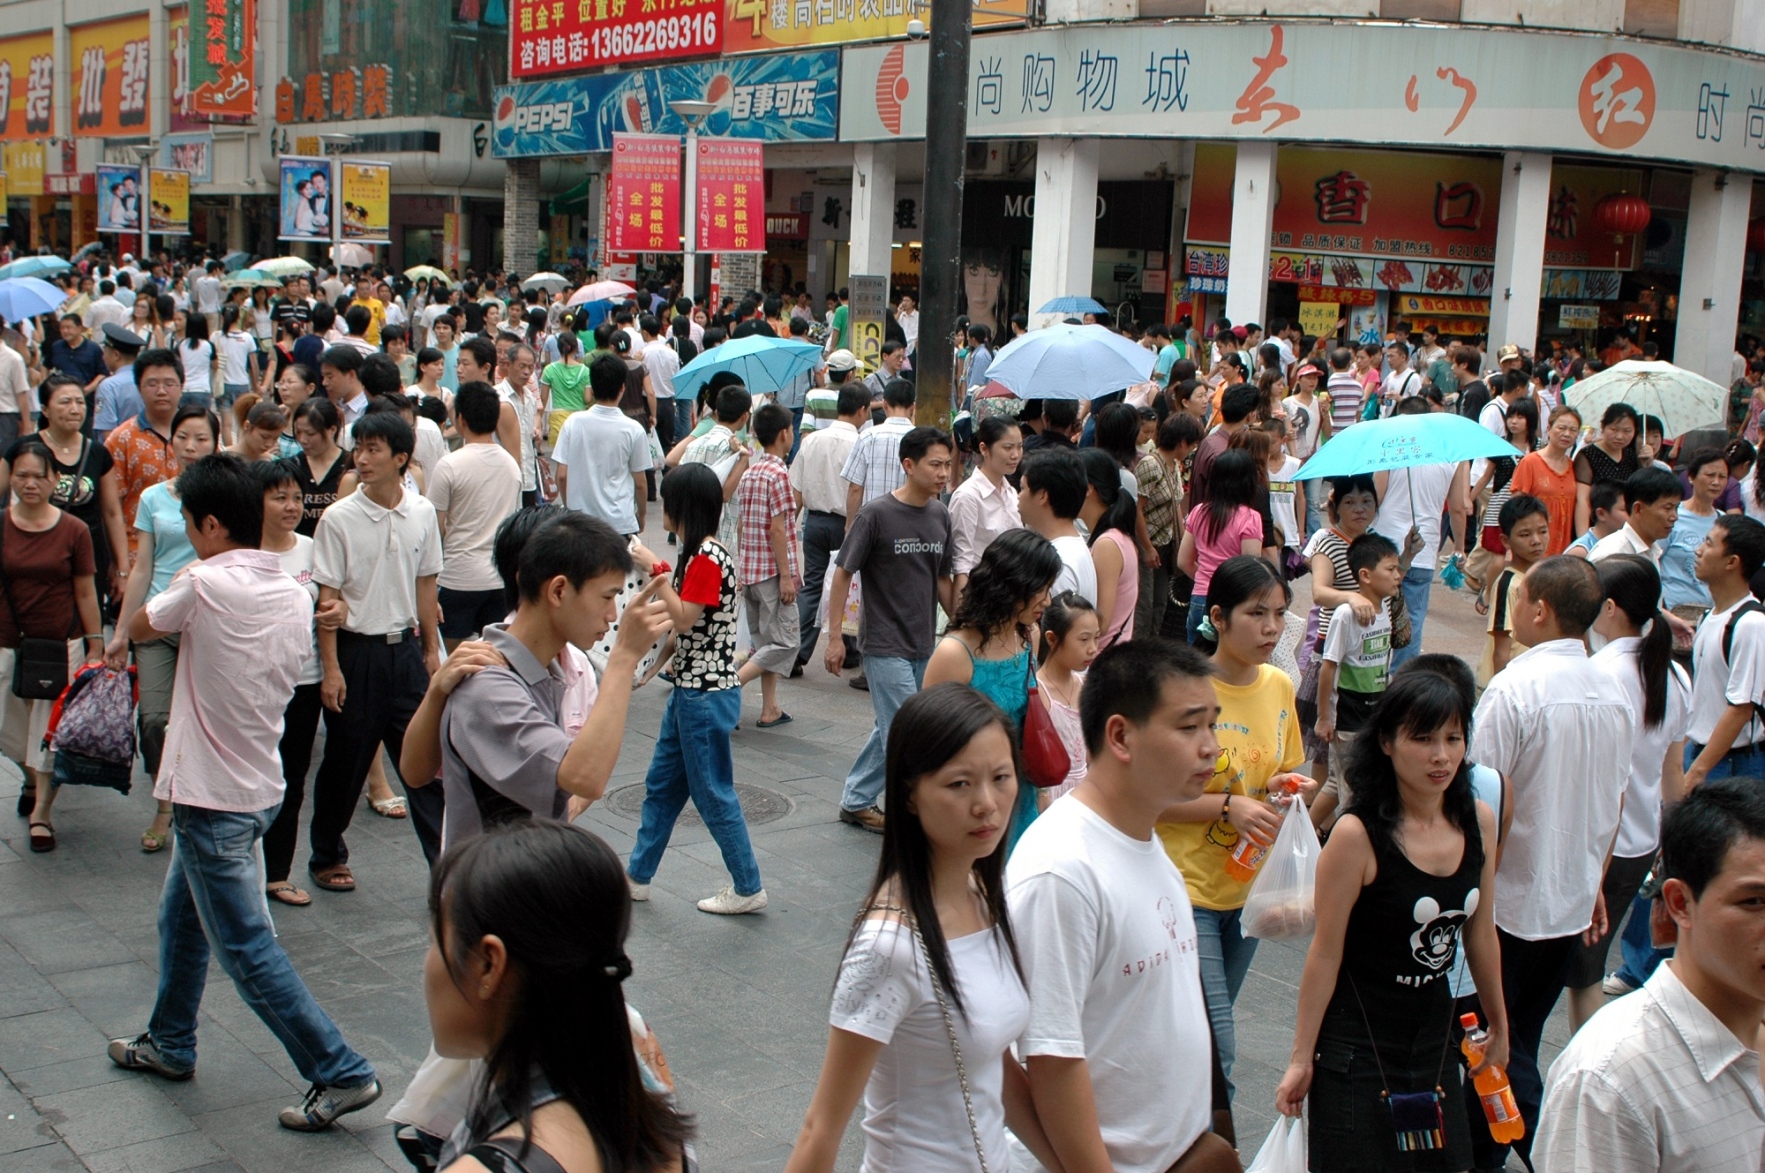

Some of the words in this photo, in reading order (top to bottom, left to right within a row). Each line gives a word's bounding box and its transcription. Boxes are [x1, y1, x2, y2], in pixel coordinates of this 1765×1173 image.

[520, 2, 565, 33] 租金平
[732, 79, 818, 120] 百事可乐
[514, 102, 573, 134] PEPSI
[629, 192, 644, 228] 全场
[649, 182, 664, 248] 批发最低价
[713, 193, 728, 229] 全场
[733, 183, 749, 248] 批发最低价
[1302, 234, 1362, 252] 品质保证
[1190, 276, 1229, 292] 珍珠奶
